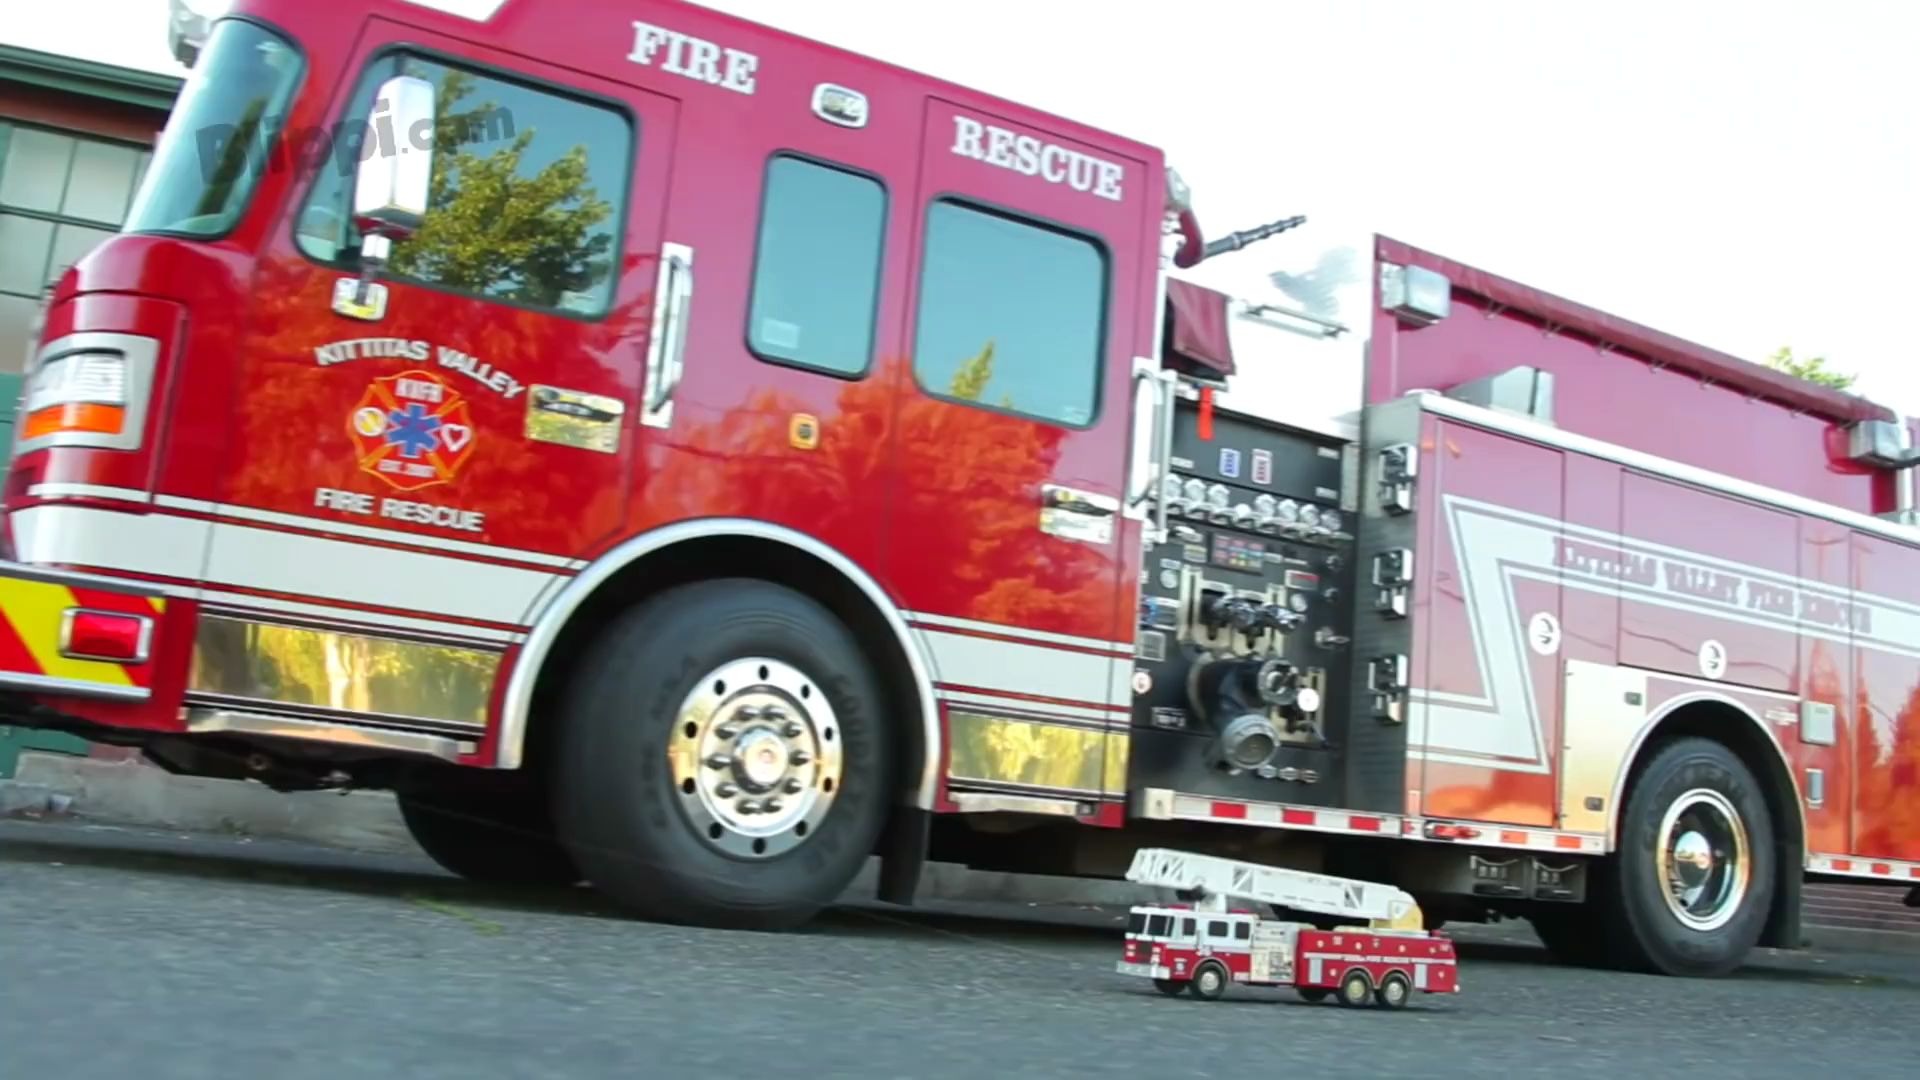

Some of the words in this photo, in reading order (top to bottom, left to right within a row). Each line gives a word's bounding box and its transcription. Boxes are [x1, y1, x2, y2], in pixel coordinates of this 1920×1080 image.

[626, 20, 759, 95] FIRE
[951, 115, 1124, 201] RESCUE
[314, 336, 430, 366] KITTITAS
[436, 345, 526, 399] VALLEY
[314, 487, 375, 515] FIRE
[380, 498, 486, 533] RESCUE
